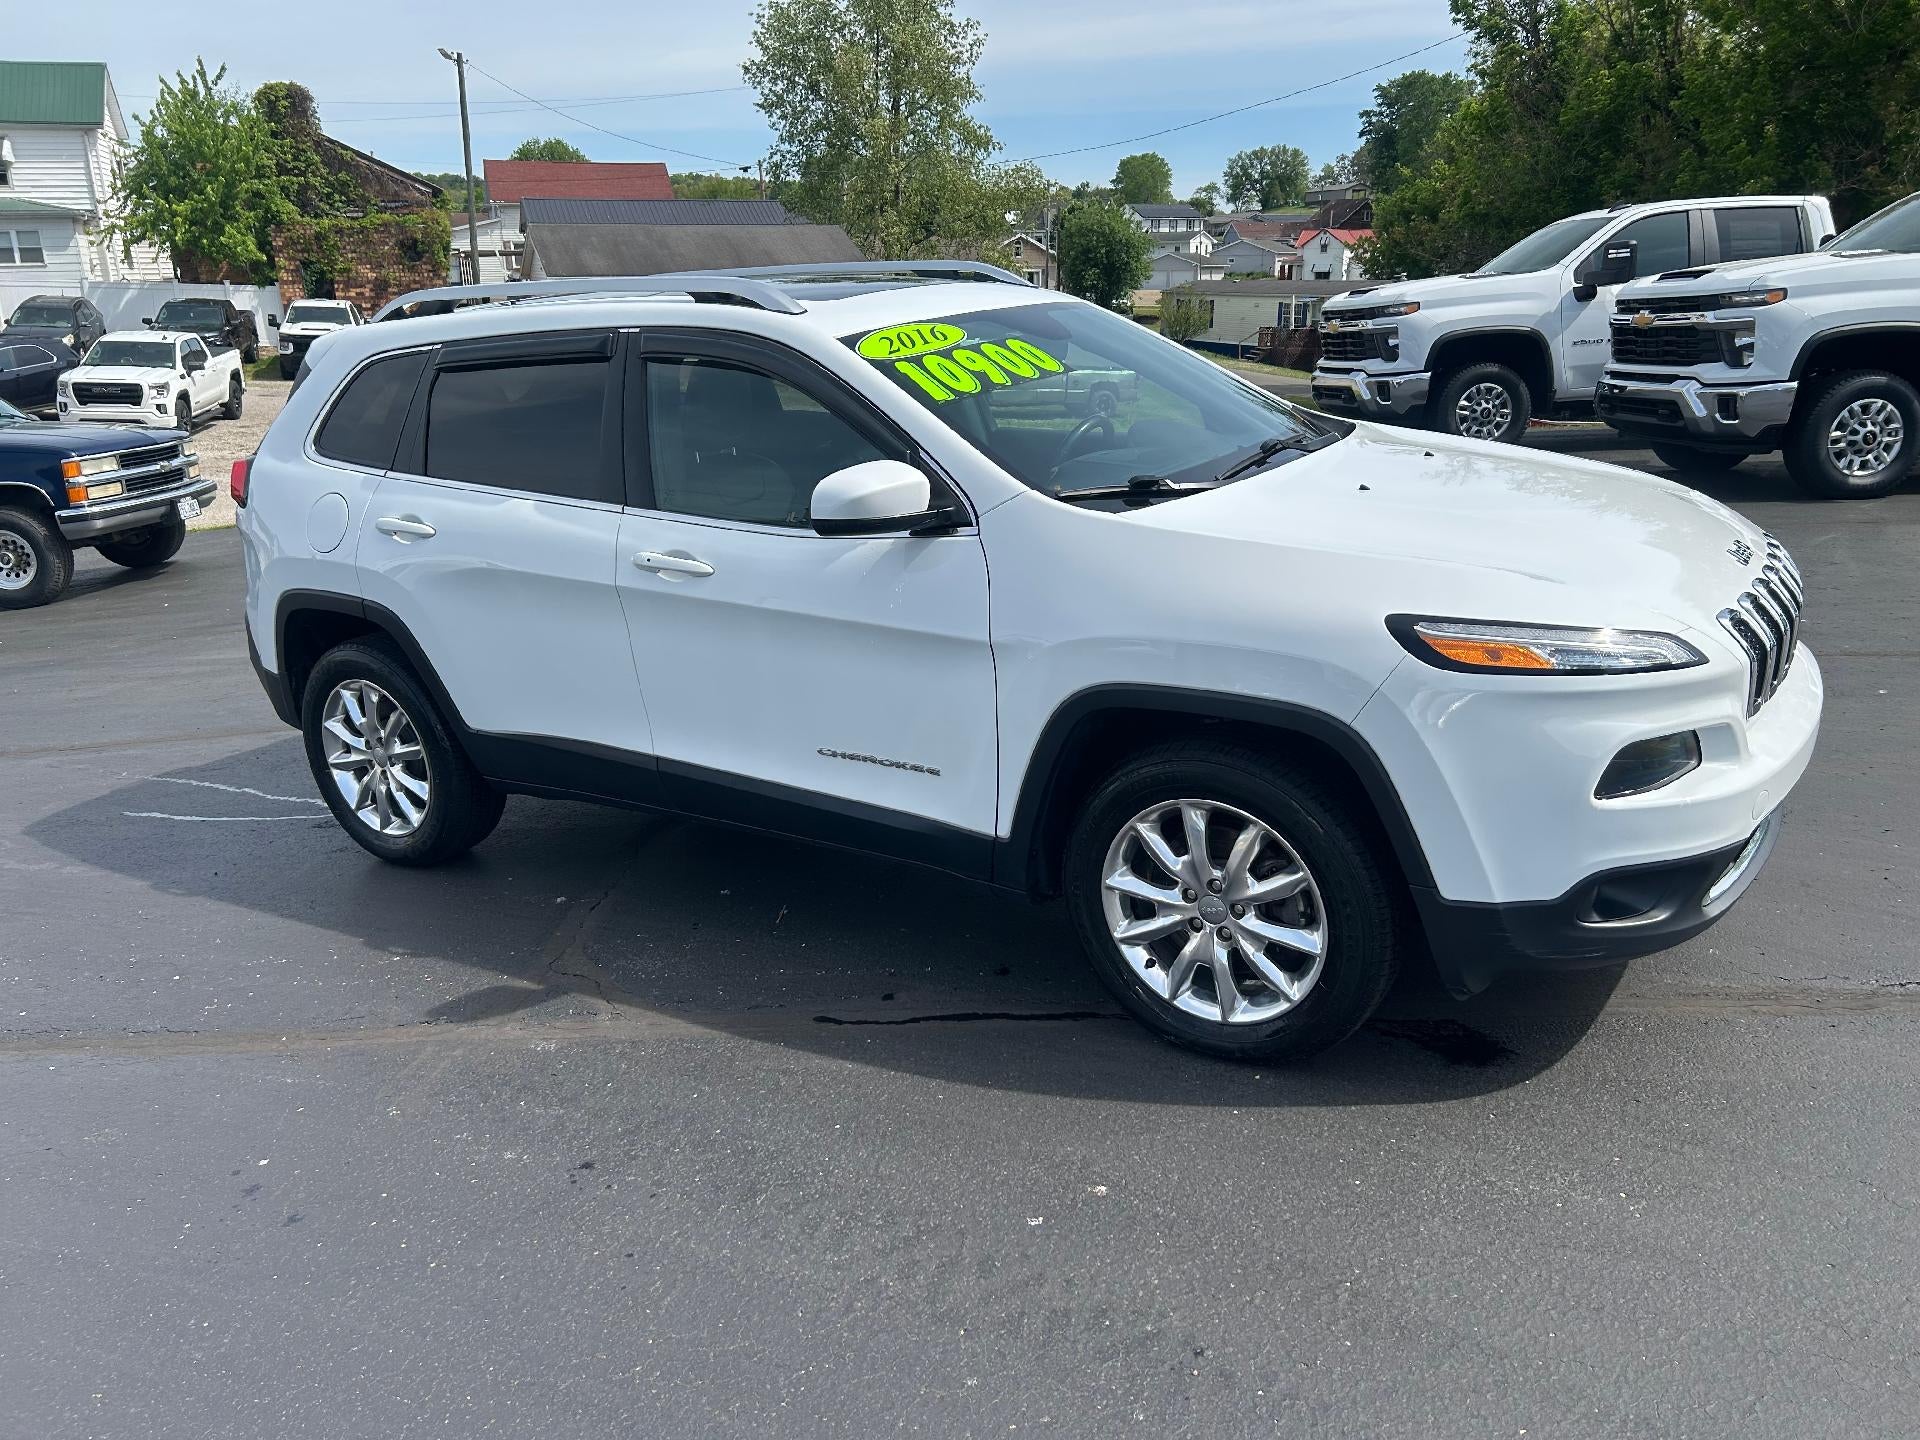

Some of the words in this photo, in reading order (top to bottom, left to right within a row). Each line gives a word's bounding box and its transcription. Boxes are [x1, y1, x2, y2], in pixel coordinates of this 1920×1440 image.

[878, 325, 949, 356] 2016
[894, 338, 1065, 401] 10900
[816, 747, 942, 777] CHEROKEE
